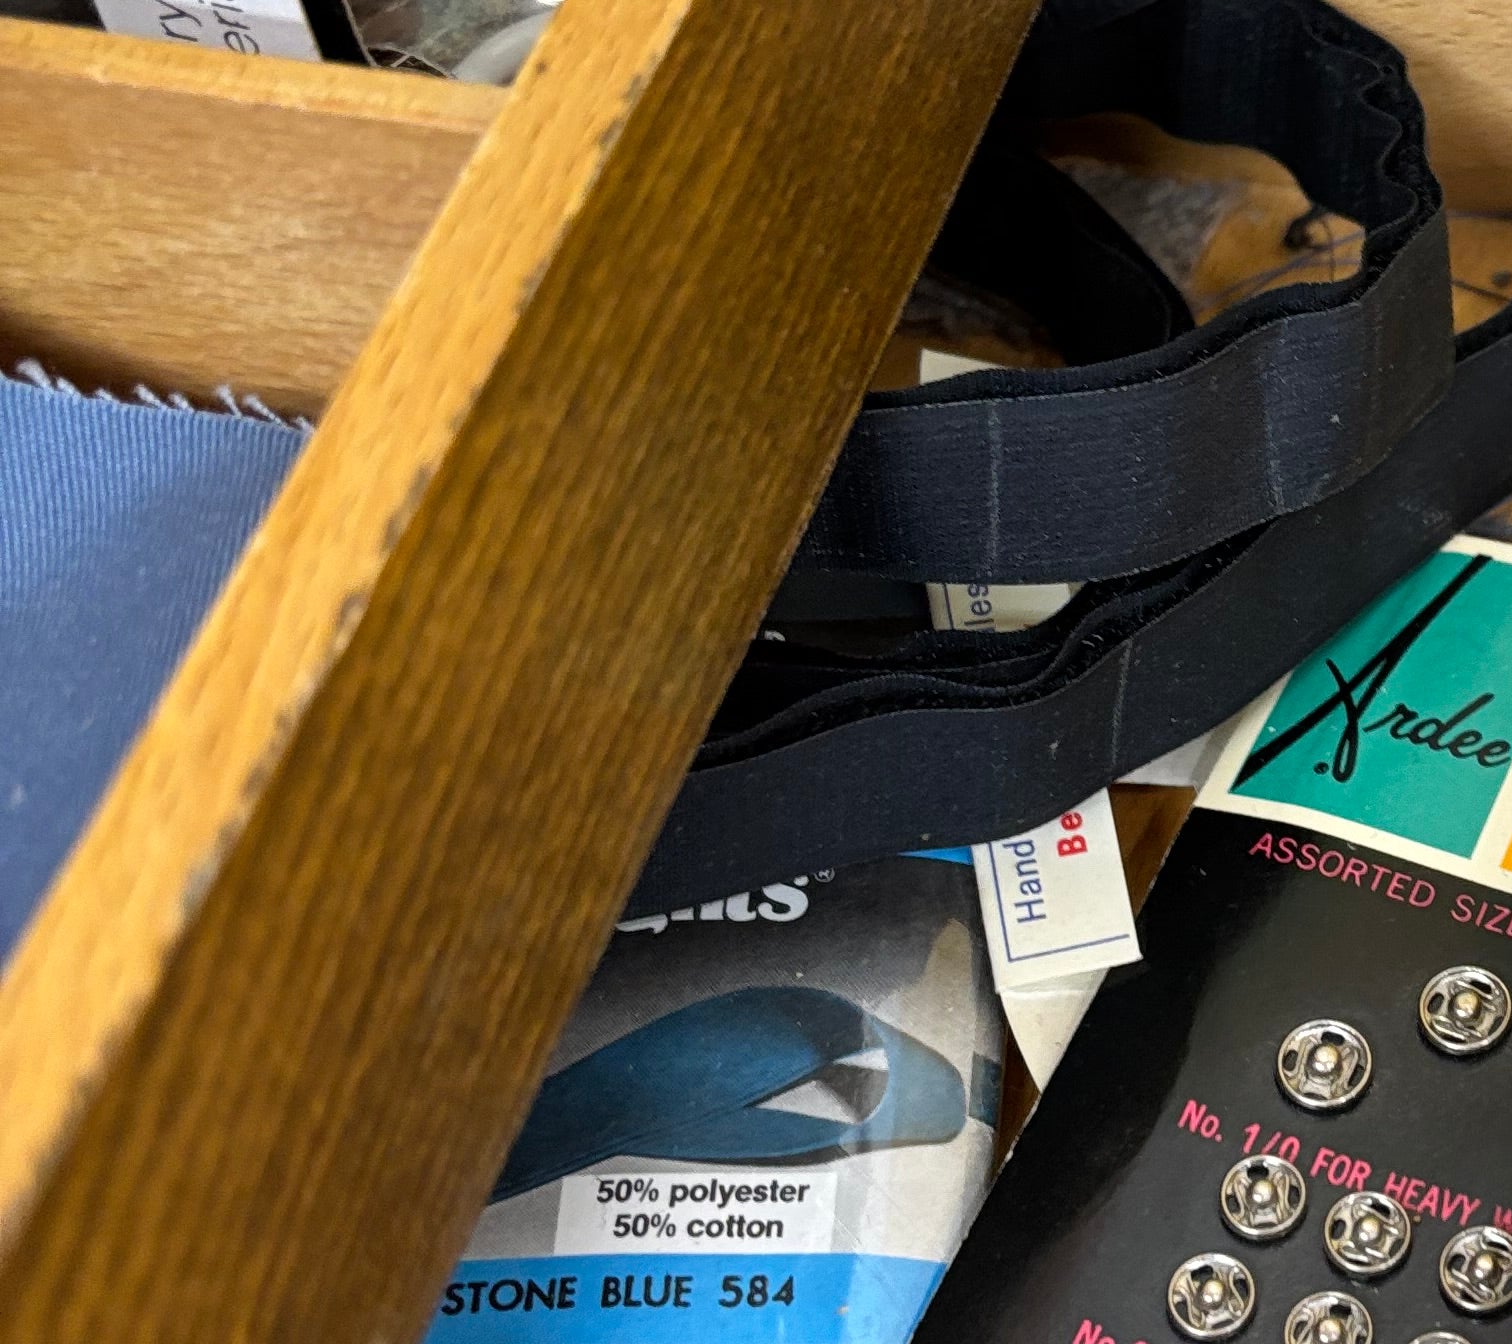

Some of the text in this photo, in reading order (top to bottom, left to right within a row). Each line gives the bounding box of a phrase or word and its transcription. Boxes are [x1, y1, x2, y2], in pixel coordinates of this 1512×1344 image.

[1231, 553, 1512, 794] Ardee
[1002, 839, 1048, 924] Hand
[1248, 832, 1436, 910] ASSORTED
[597, 1176, 811, 1210] 50% polyester
[1178, 1099, 1224, 1143] No.
[1309, 1146, 1371, 1192] FOR
[1383, 1170, 1482, 1225] HEAVY
[612, 1212, 785, 1240] 50% cotton
[440, 1273, 797, 1318] STONE BLUE 584
